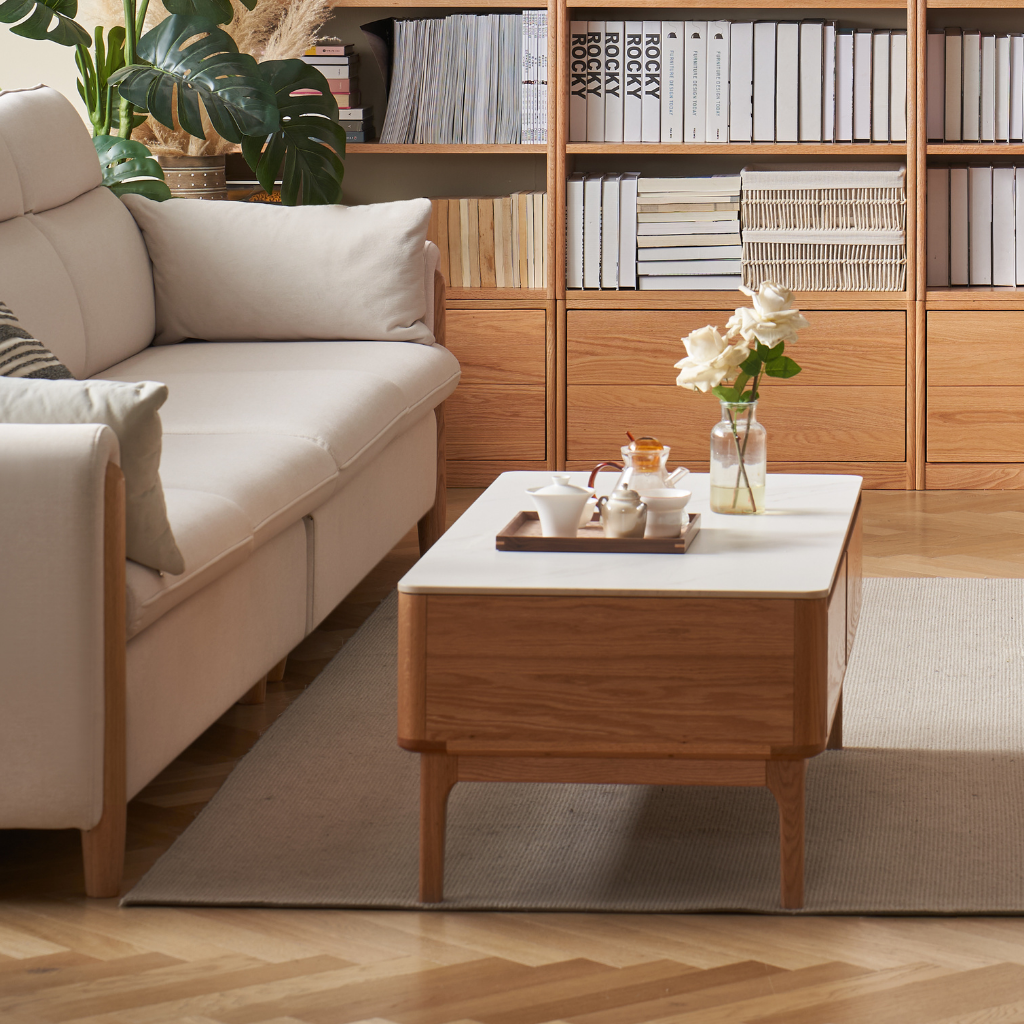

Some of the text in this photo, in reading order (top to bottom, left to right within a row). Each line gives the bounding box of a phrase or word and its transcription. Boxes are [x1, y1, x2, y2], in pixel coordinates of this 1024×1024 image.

[571, 34, 587, 100] ROCKY
[587, 32, 601, 98] ROCKY
[605, 32, 620, 98] ROCKY
[627, 34, 642, 100] ROCKY
[645, 34, 660, 100] ROCKY
